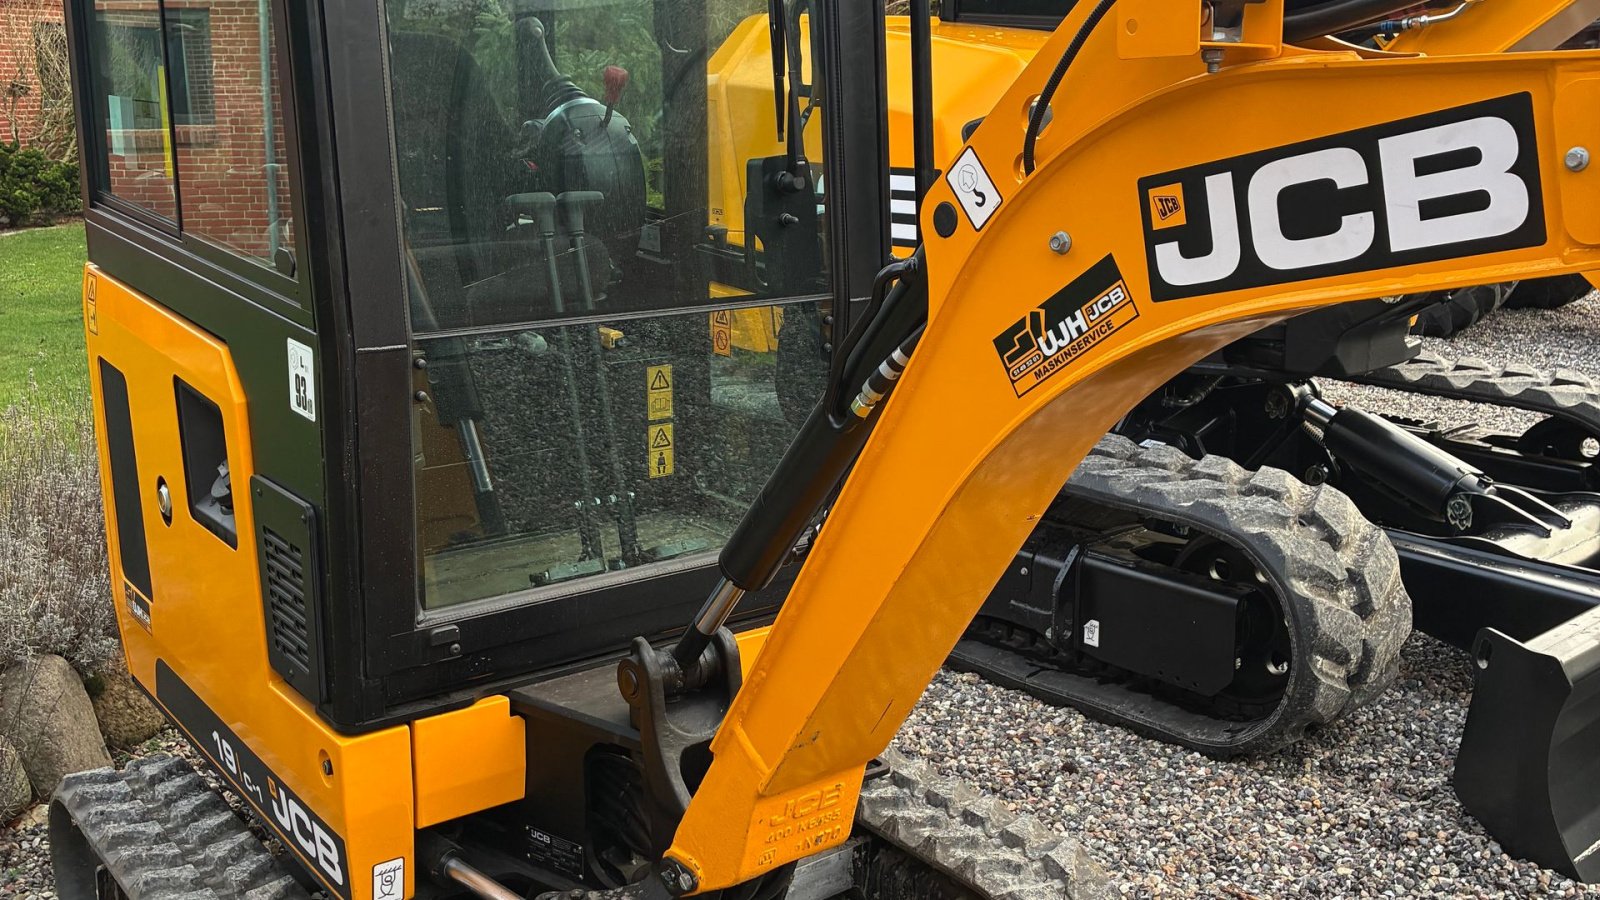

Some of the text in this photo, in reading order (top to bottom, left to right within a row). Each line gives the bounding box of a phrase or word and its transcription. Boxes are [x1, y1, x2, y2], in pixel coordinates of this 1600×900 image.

[1155, 116, 1529, 287] JCB
[1157, 197, 1179, 217] JCB
[1037, 287, 1125, 356] UJH JCB
[1033, 320, 1114, 380] MASKINSERVICE
[294, 372, 307, 411] 93
[212, 730, 237, 775] 19
[769, 782, 845, 828] JCB
[271, 787, 344, 886] JCB
[530, 829, 551, 844] JCB
